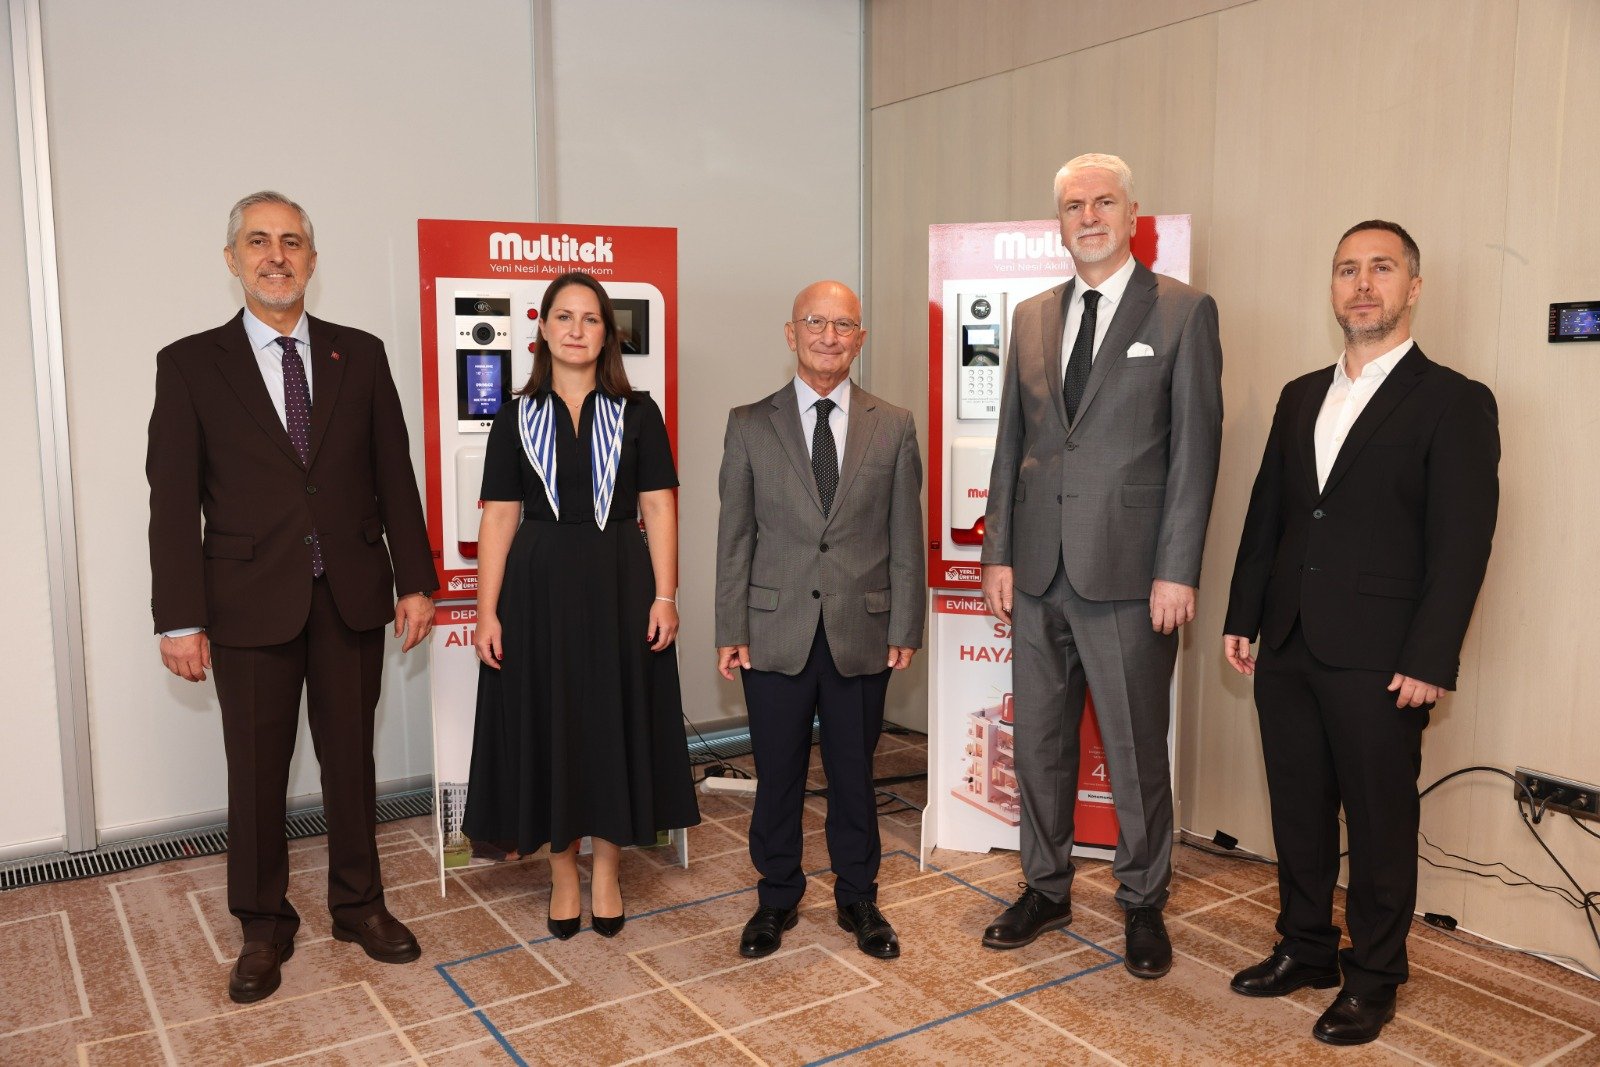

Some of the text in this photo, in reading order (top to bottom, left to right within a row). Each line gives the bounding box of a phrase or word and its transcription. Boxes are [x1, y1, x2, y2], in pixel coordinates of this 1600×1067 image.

[489, 232, 613, 263] Multitek
[994, 231, 1070, 259] Mult
[490, 264, 512, 273] Yeni
[514, 264, 539, 273] Nesil
[541, 265, 565, 274] Akıllı
[994, 263, 1015, 272] Yeni
[968, 488, 988, 498] Mul
[451, 609, 478, 620] DEP
